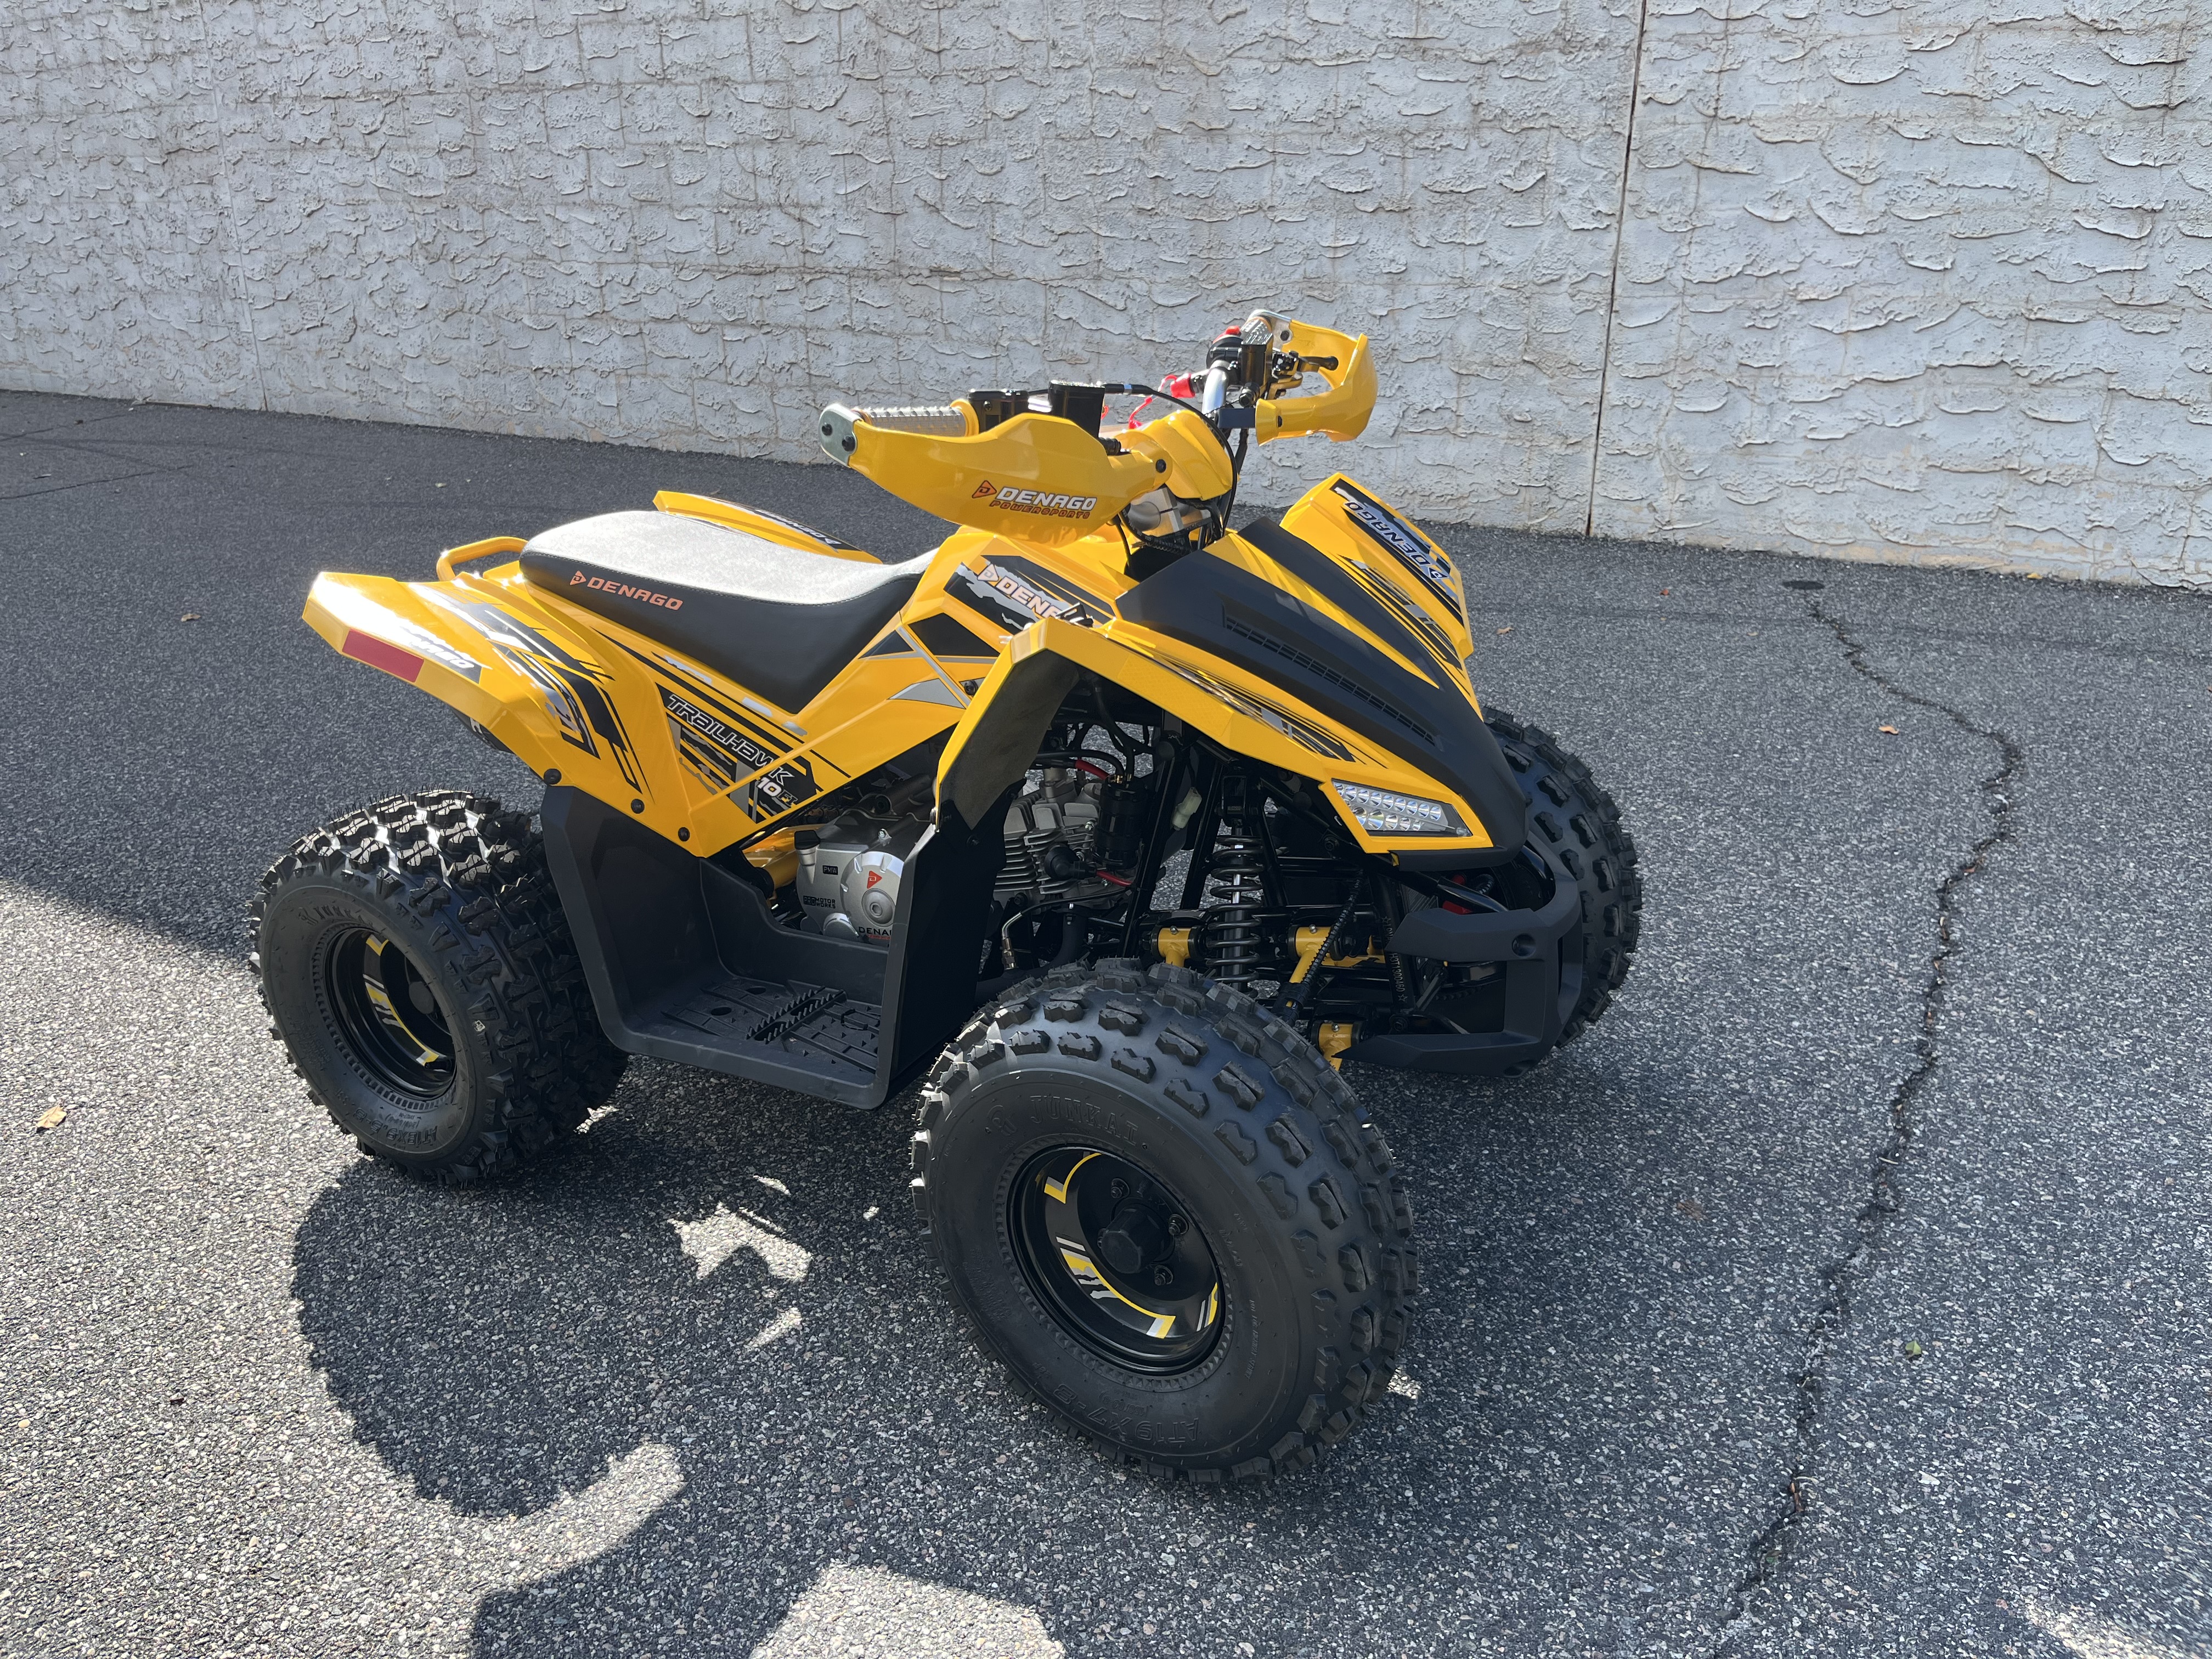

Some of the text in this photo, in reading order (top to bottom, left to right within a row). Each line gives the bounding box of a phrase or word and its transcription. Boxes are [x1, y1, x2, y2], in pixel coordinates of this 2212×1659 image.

[989, 500, 1091, 519] POWERSPORTS
[995, 486, 1098, 511] DENAGO
[1342, 501, 1431, 566] DENAGO
[586, 577, 684, 611] DENAGO
[995, 575, 1063, 618] DENA
[858, 926, 892, 936] DENA
